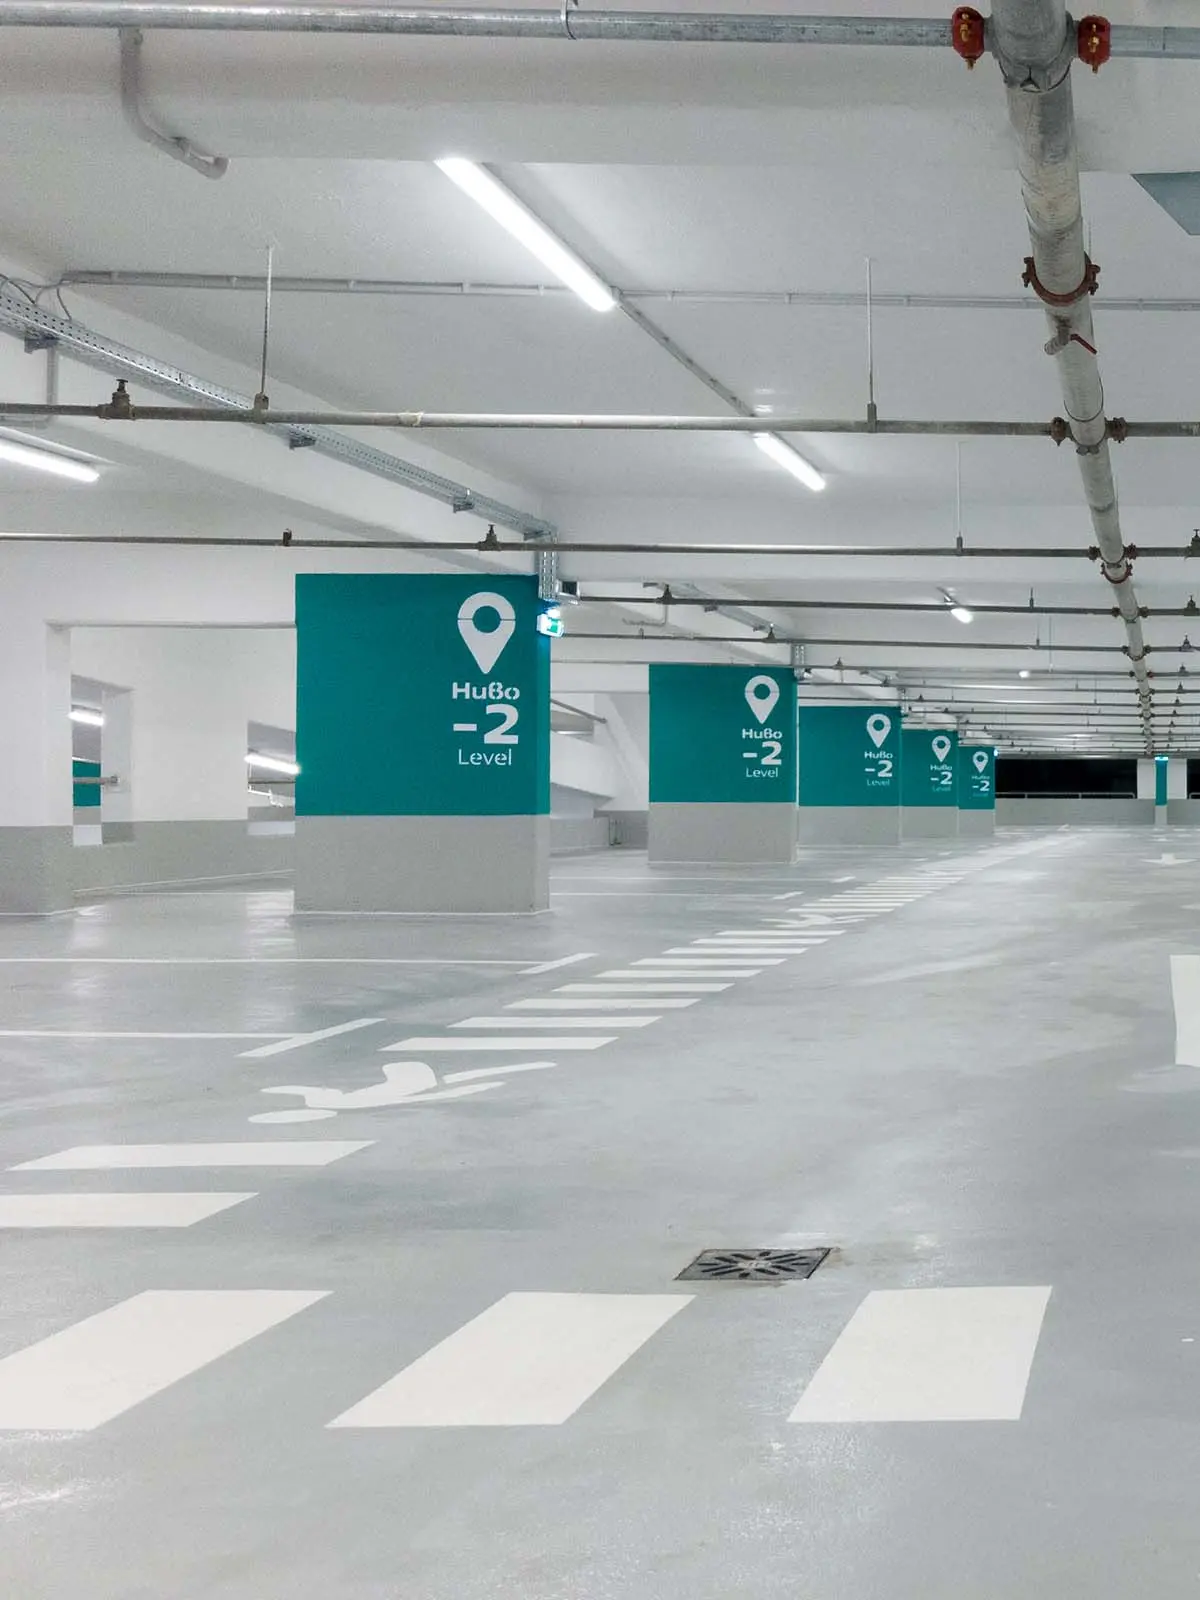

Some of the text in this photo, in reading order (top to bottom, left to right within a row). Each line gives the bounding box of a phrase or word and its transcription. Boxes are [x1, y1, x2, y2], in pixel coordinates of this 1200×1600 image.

[453, 704, 519, 745] -2
[458, 748, 512, 766] Level
[742, 741, 783, 765] -2
[746, 767, 779, 778] Level
[865, 760, 893, 777] -2
[930, 772, 953, 785] -2
